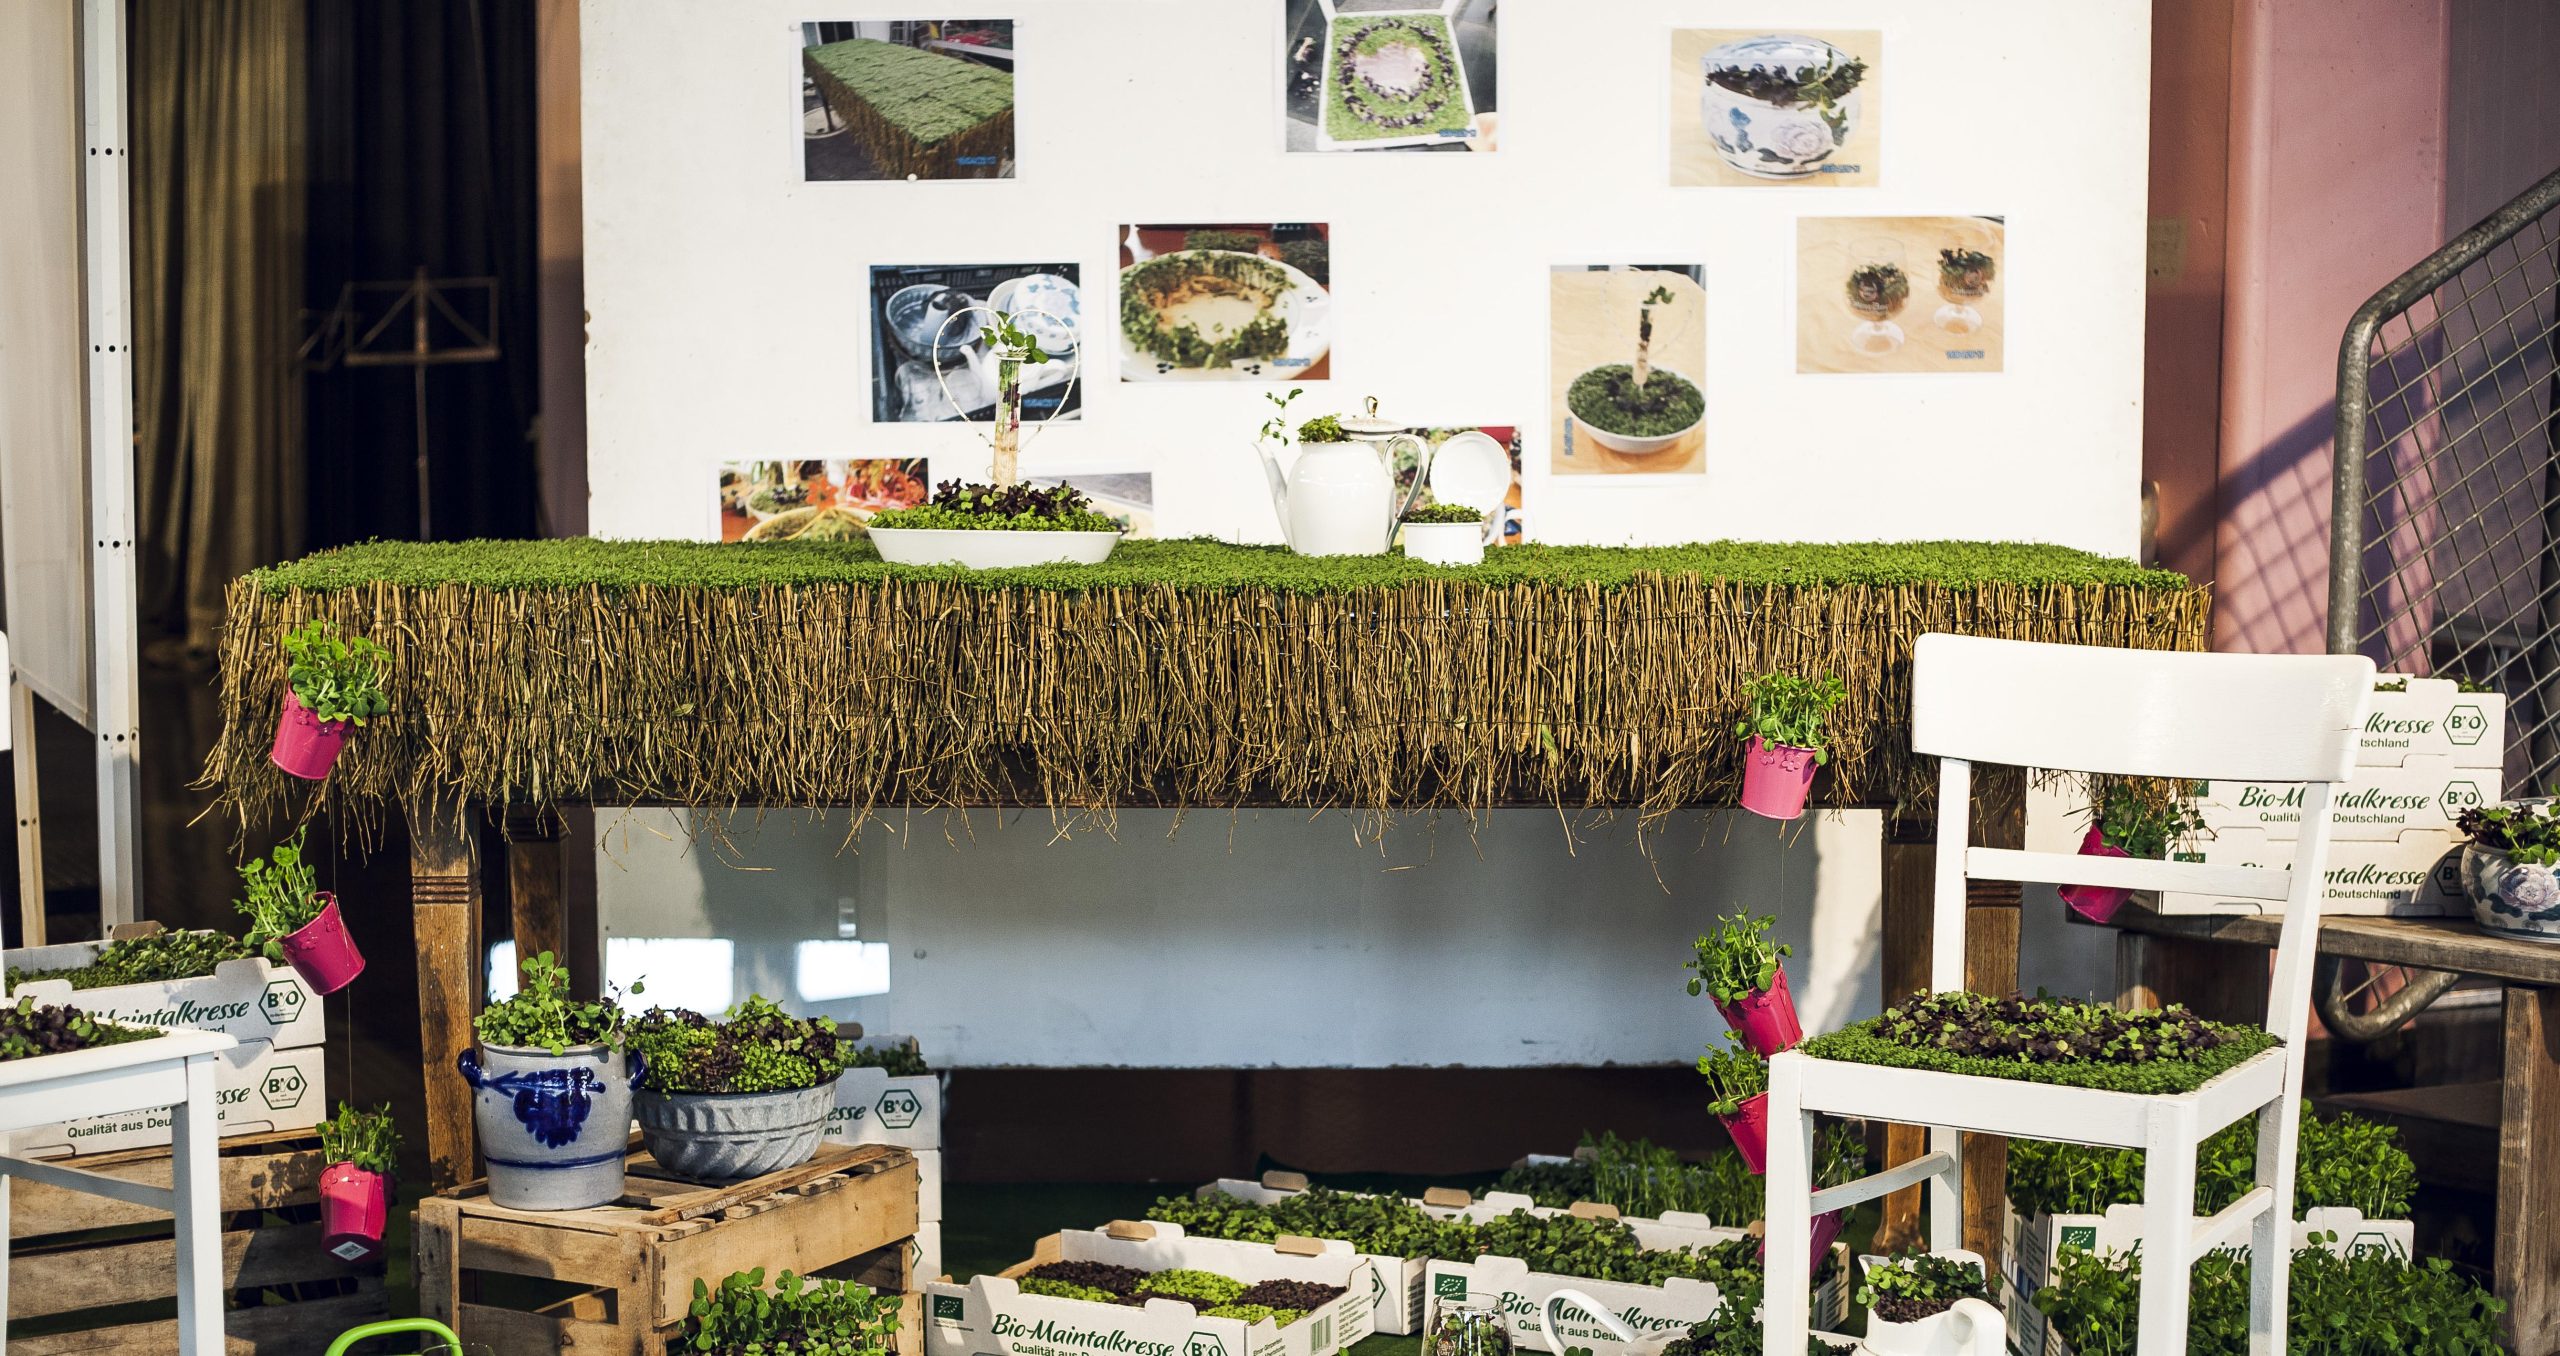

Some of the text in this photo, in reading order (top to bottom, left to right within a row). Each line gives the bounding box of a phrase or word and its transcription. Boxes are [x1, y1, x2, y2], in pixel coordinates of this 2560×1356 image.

[2360, 738, 2409, 748] tschland
[2260, 811, 2405, 824] Qualitä Deutschland
[2329, 888, 2401, 899] Deutschland
[67, 1123, 117, 1138] Qualität
[120, 1120, 143, 1132] aus
[991, 1313, 1175, 1356] Bio-Maintalkresse
[1567, 1327, 1589, 1338] aus
[1012, 1342, 1055, 1356] Qualität
